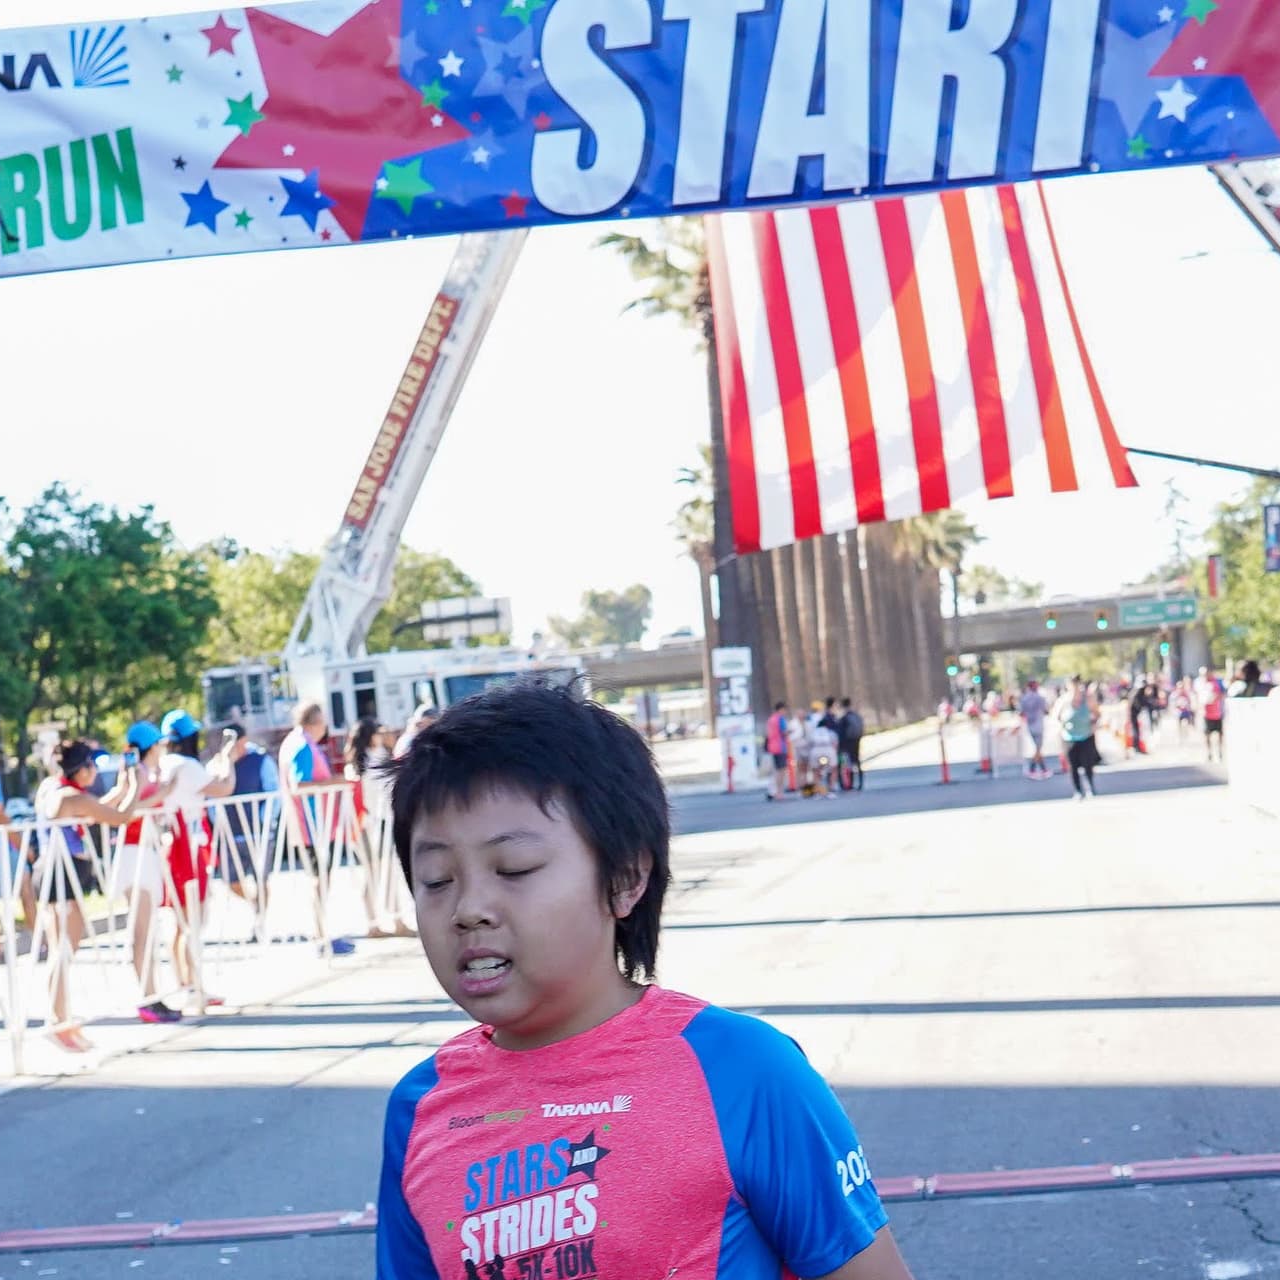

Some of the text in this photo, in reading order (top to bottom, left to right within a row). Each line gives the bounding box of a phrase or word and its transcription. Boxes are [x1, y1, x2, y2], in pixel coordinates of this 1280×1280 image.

[346, 477, 379, 521] SAN
[367, 418, 402, 478] JOSE
[391, 360, 426, 419] FIRE
[541, 1101, 611, 1118] TARANA
[464, 1137, 598, 1212] STARS AND
[461, 1183, 599, 1265] STRIDES
